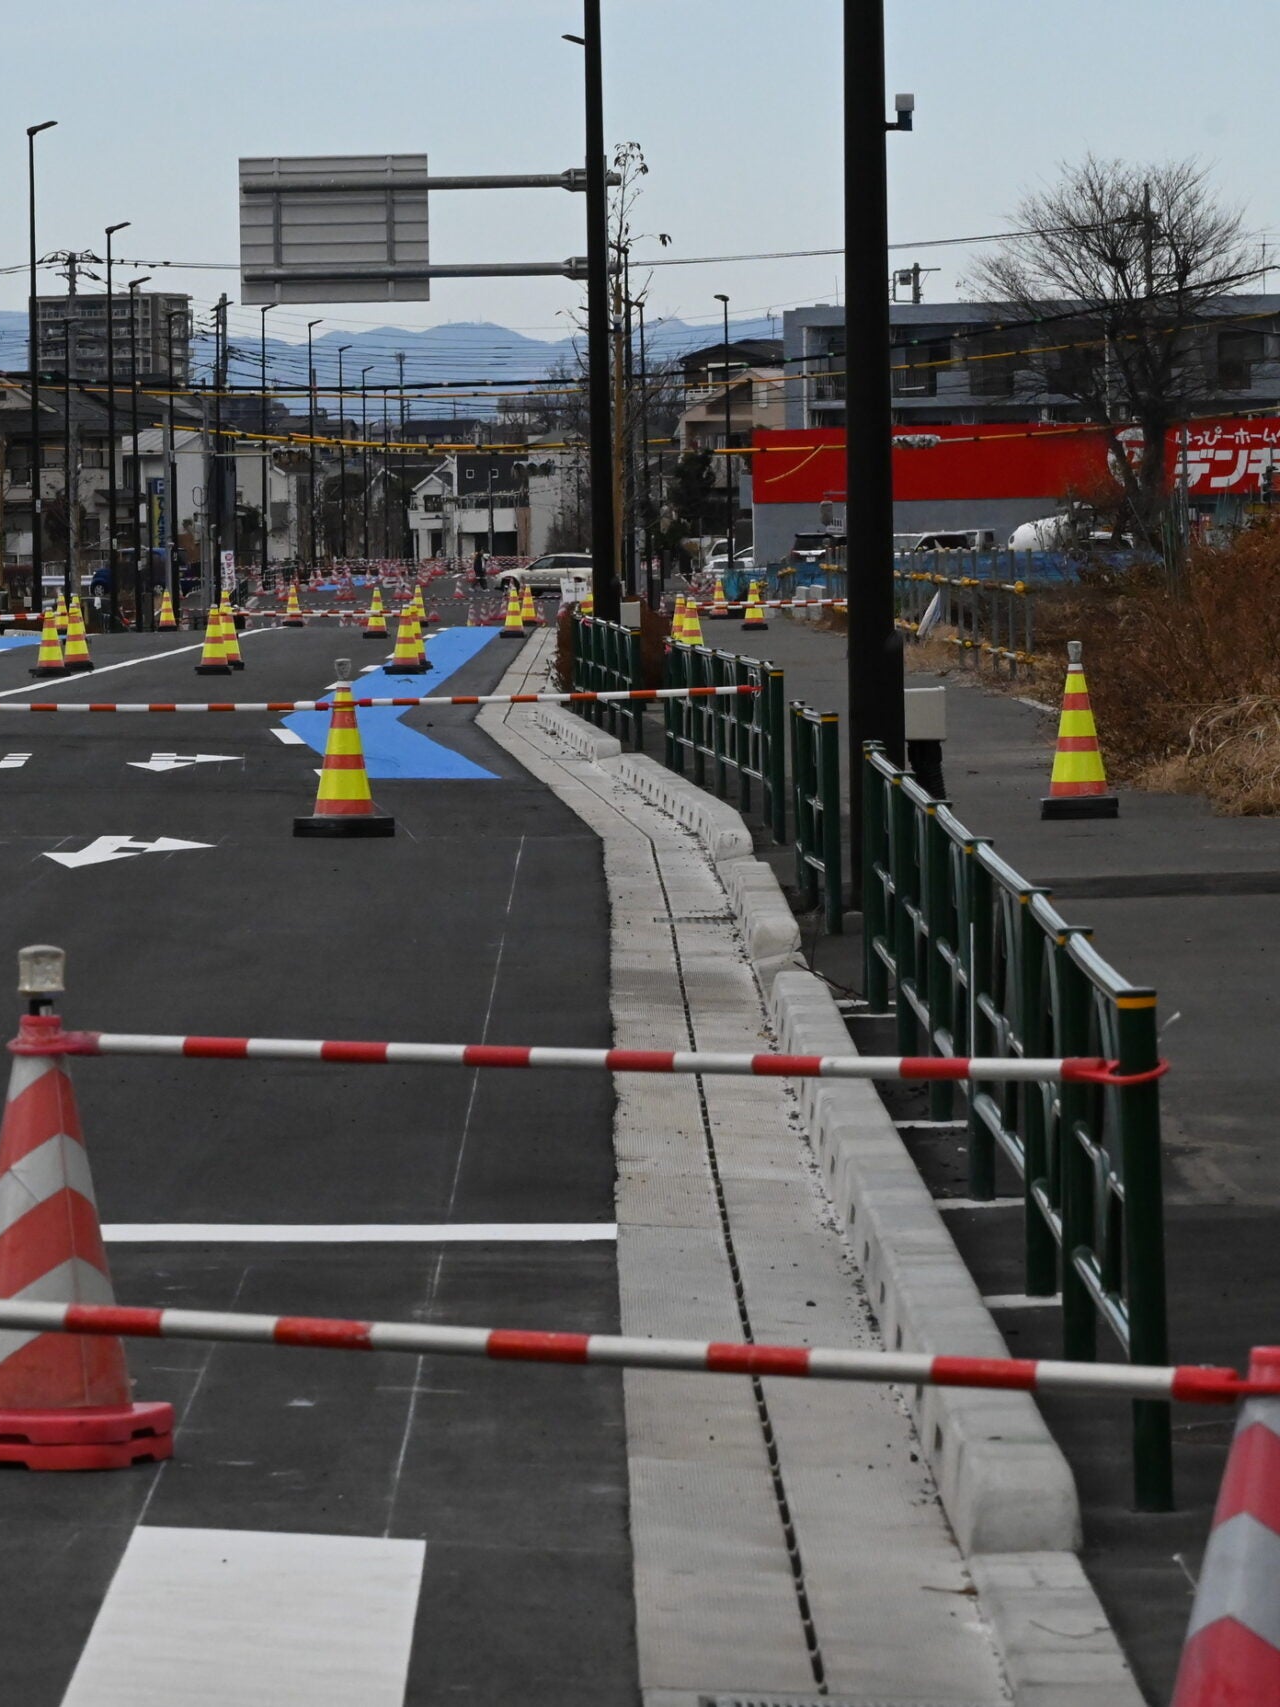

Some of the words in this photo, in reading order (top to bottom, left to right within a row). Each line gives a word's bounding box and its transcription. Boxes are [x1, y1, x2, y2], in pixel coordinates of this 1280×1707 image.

[1175, 426, 1280, 446] はっぴーホーム
